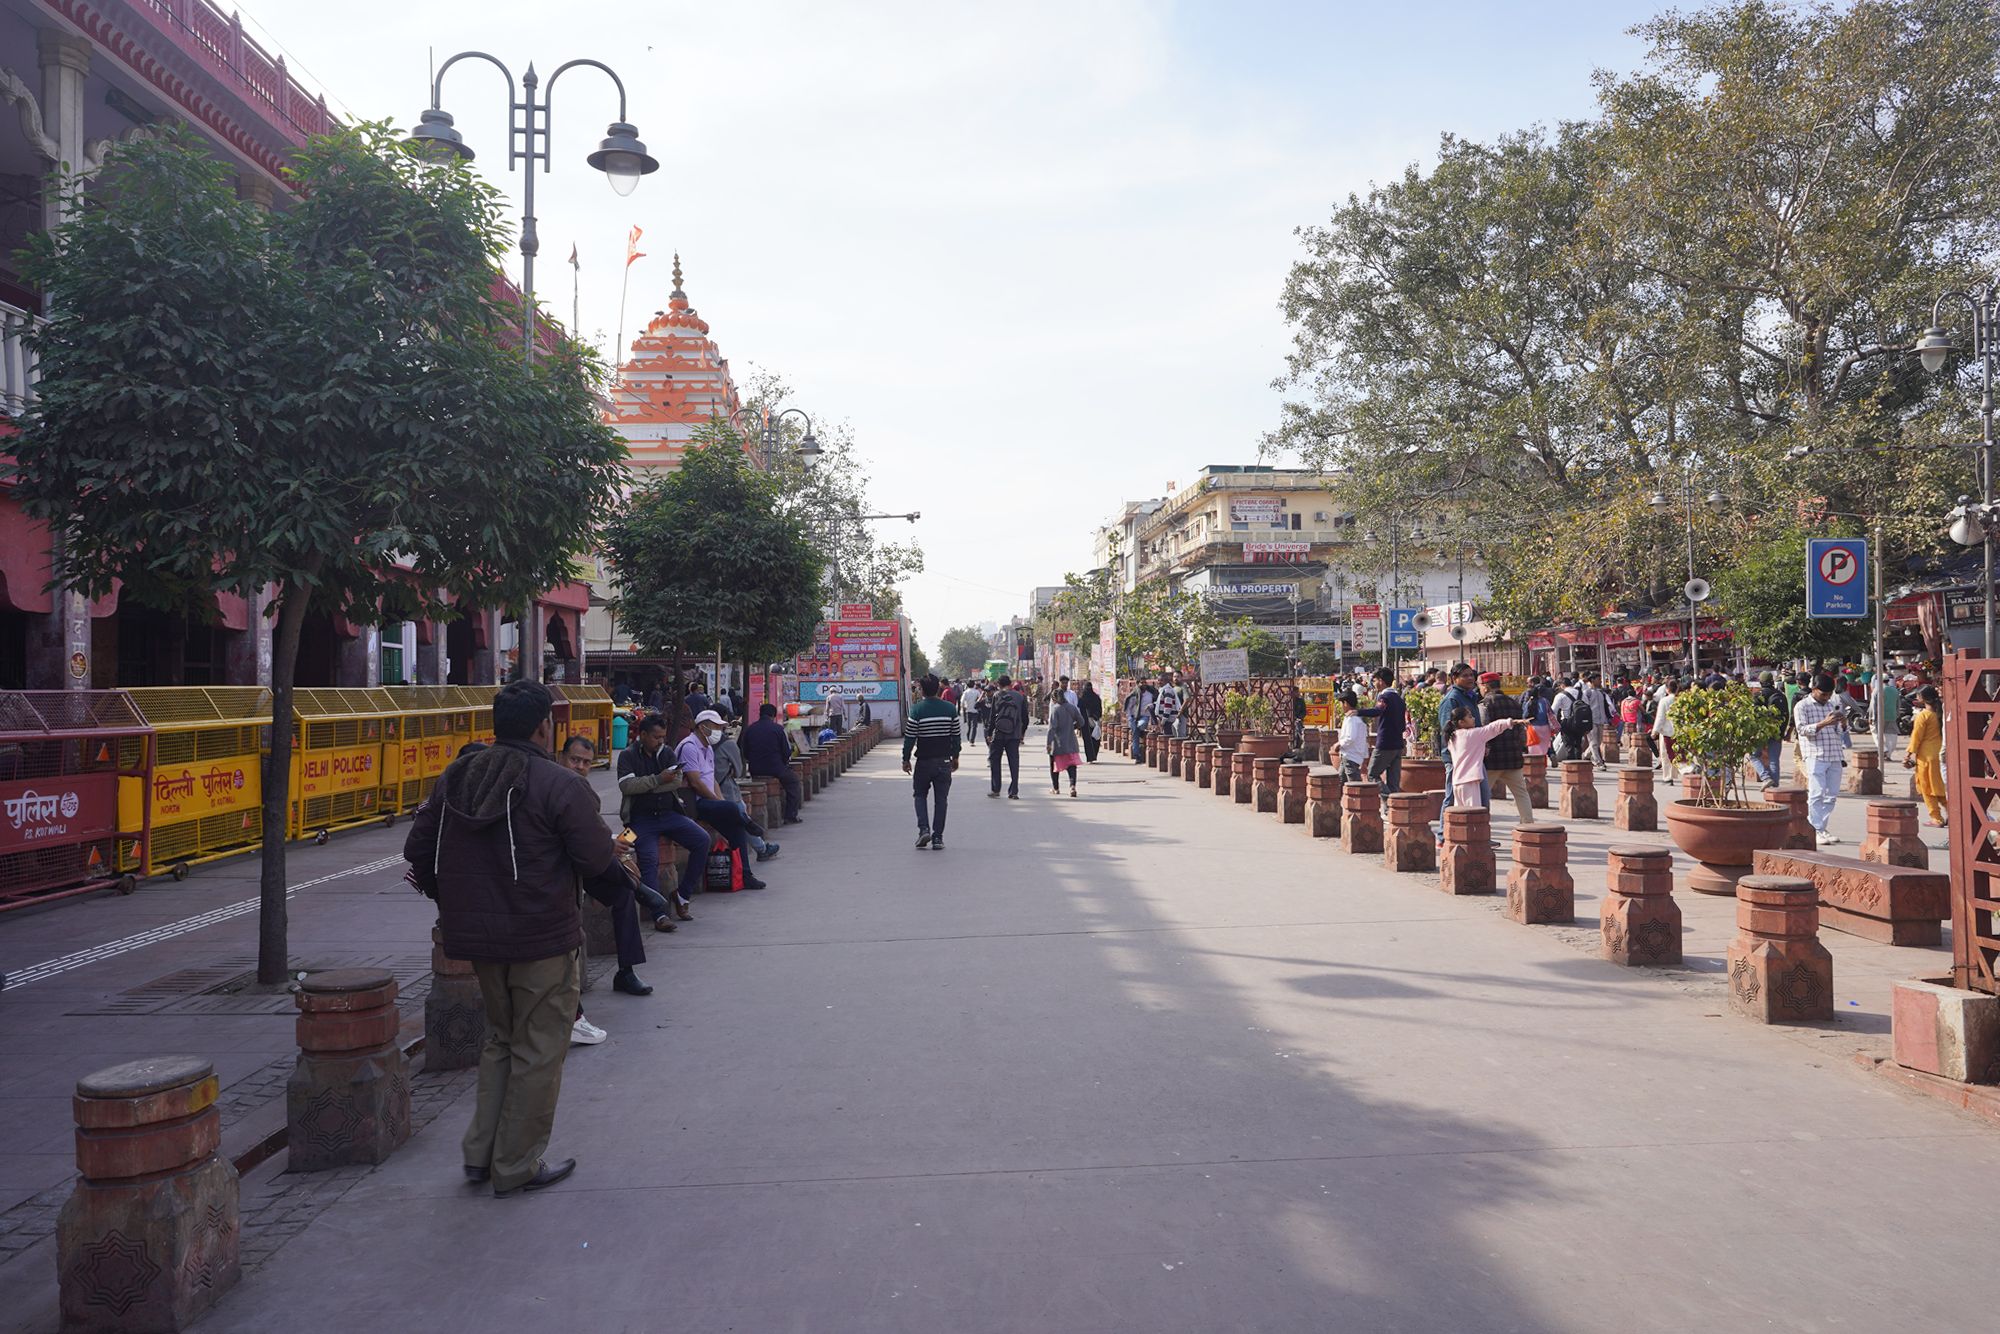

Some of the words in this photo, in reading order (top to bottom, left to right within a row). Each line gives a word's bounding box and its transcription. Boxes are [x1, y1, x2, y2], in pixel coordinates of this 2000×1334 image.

[1210, 584, 1239, 593] RANA
[1240, 584, 1295, 593] PROPERTY
[333, 755, 364, 775] POLICE
[153, 769, 196, 801] दिल्ली
[201, 766, 233, 798] पुलिस
[4, 789, 60, 829] पुलिस
